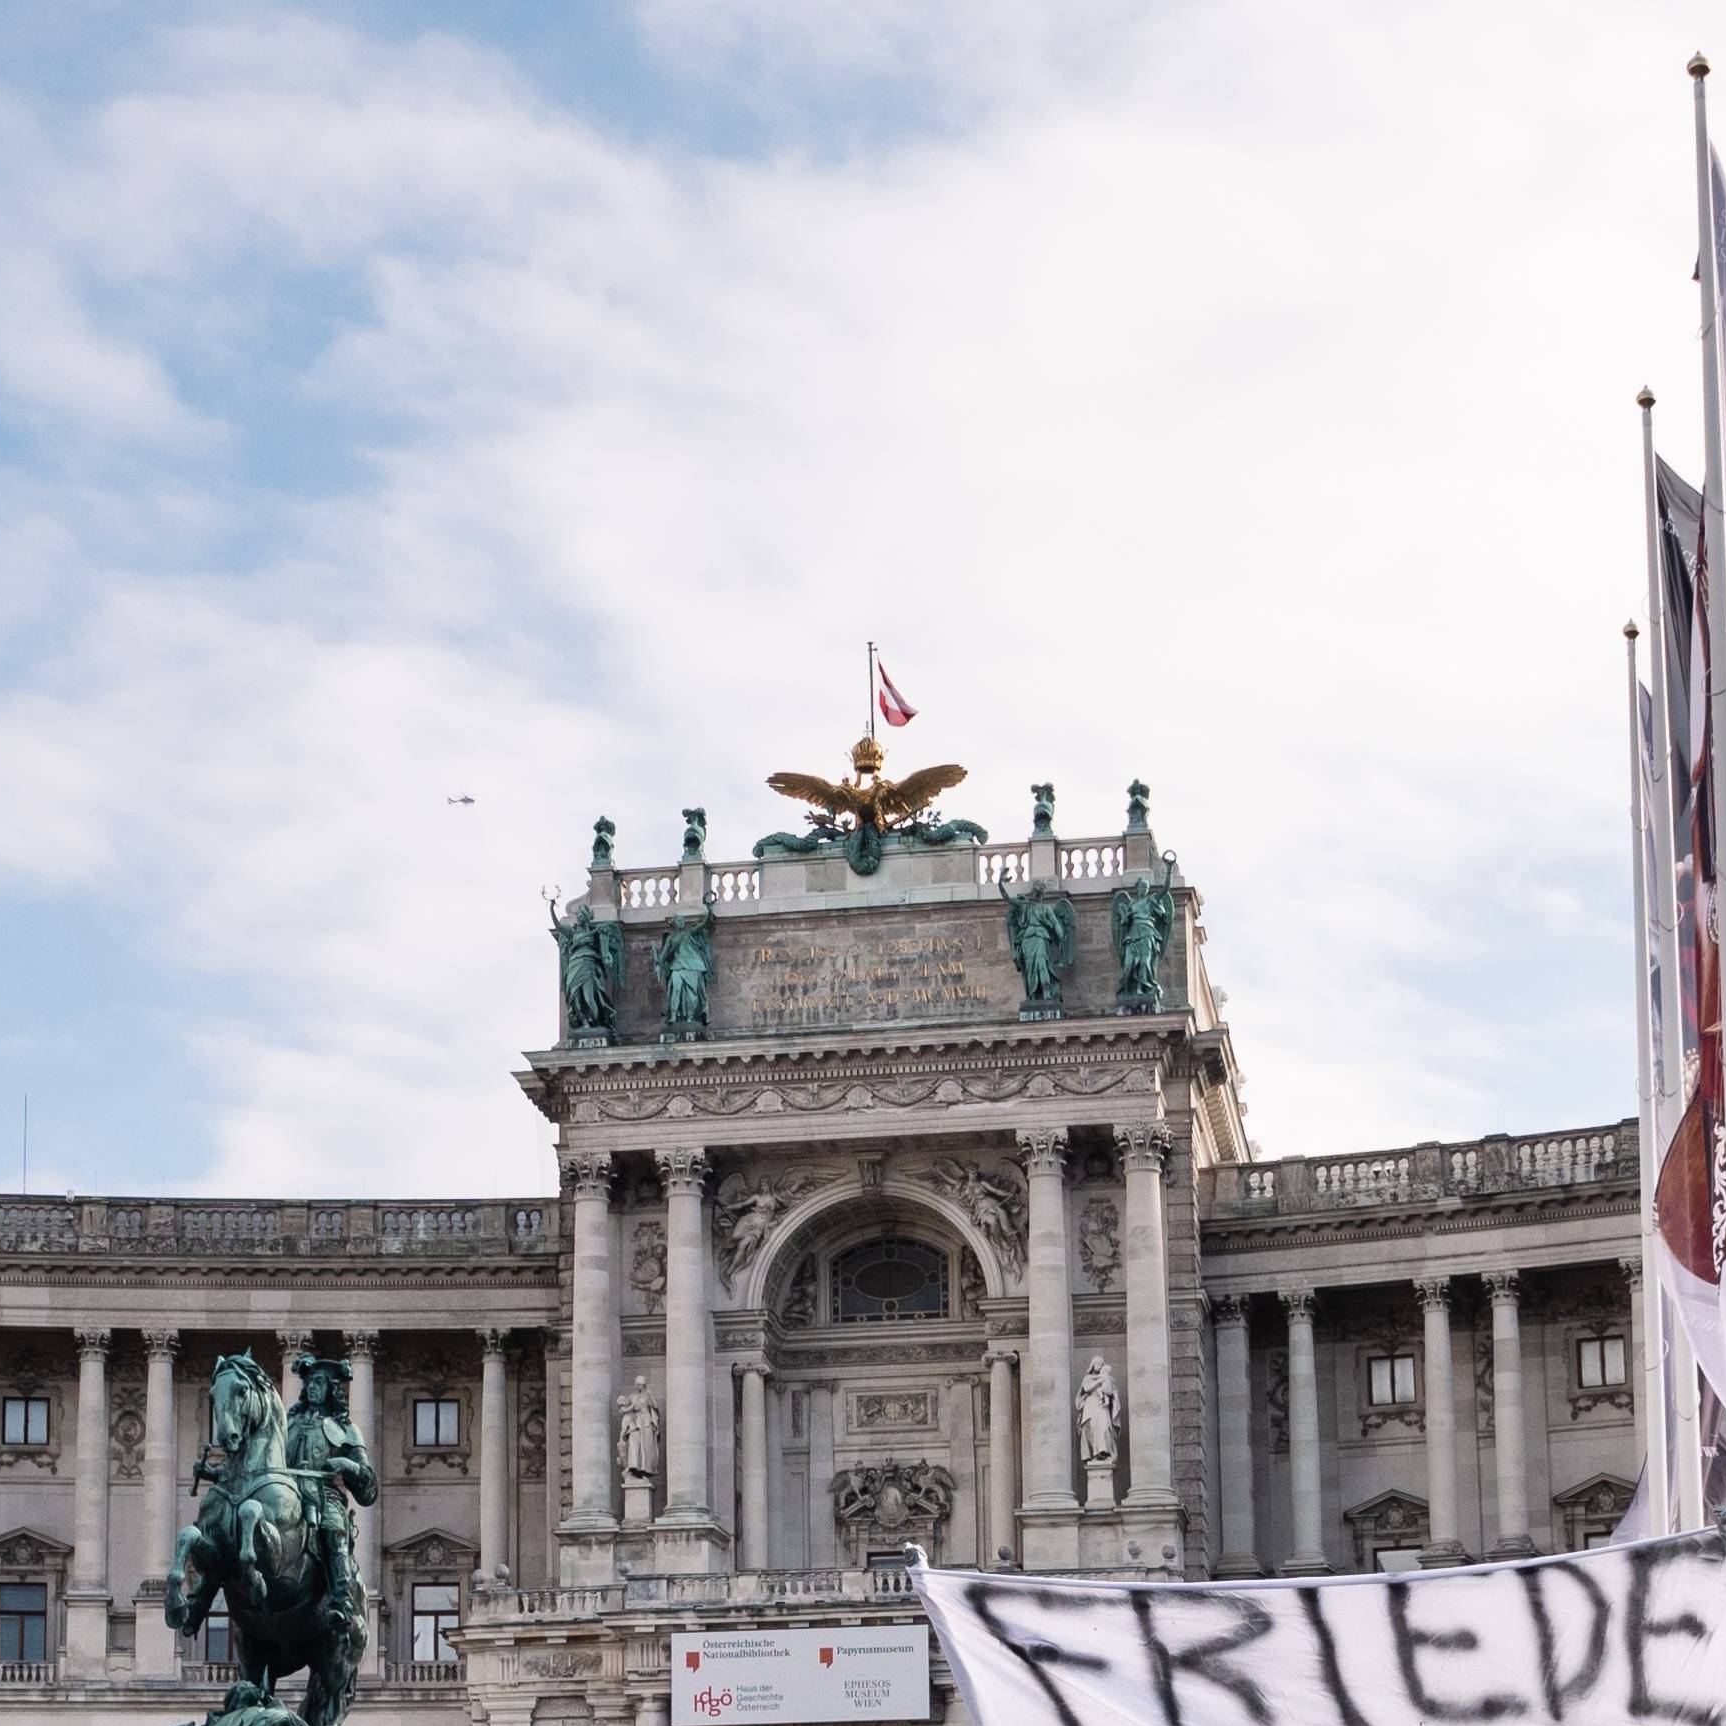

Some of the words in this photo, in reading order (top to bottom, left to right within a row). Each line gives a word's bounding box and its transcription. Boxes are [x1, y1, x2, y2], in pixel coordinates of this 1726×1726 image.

[702, 1638, 775, 1650] Österreichische
[702, 1648, 791, 1661] Nationalbibliothek
[836, 1644, 914, 1657] Papyrusmuseum
[736, 1685, 755, 1694] Haus
[759, 1684, 773, 1693] der
[844, 1680, 891, 1690] EPHESOS
[736, 1692, 784, 1703] Geschichte
[845, 1689, 890, 1700] MUSEUM
[736, 1702, 780, 1713] Österreich
[854, 1699, 882, 1709] WIEN
